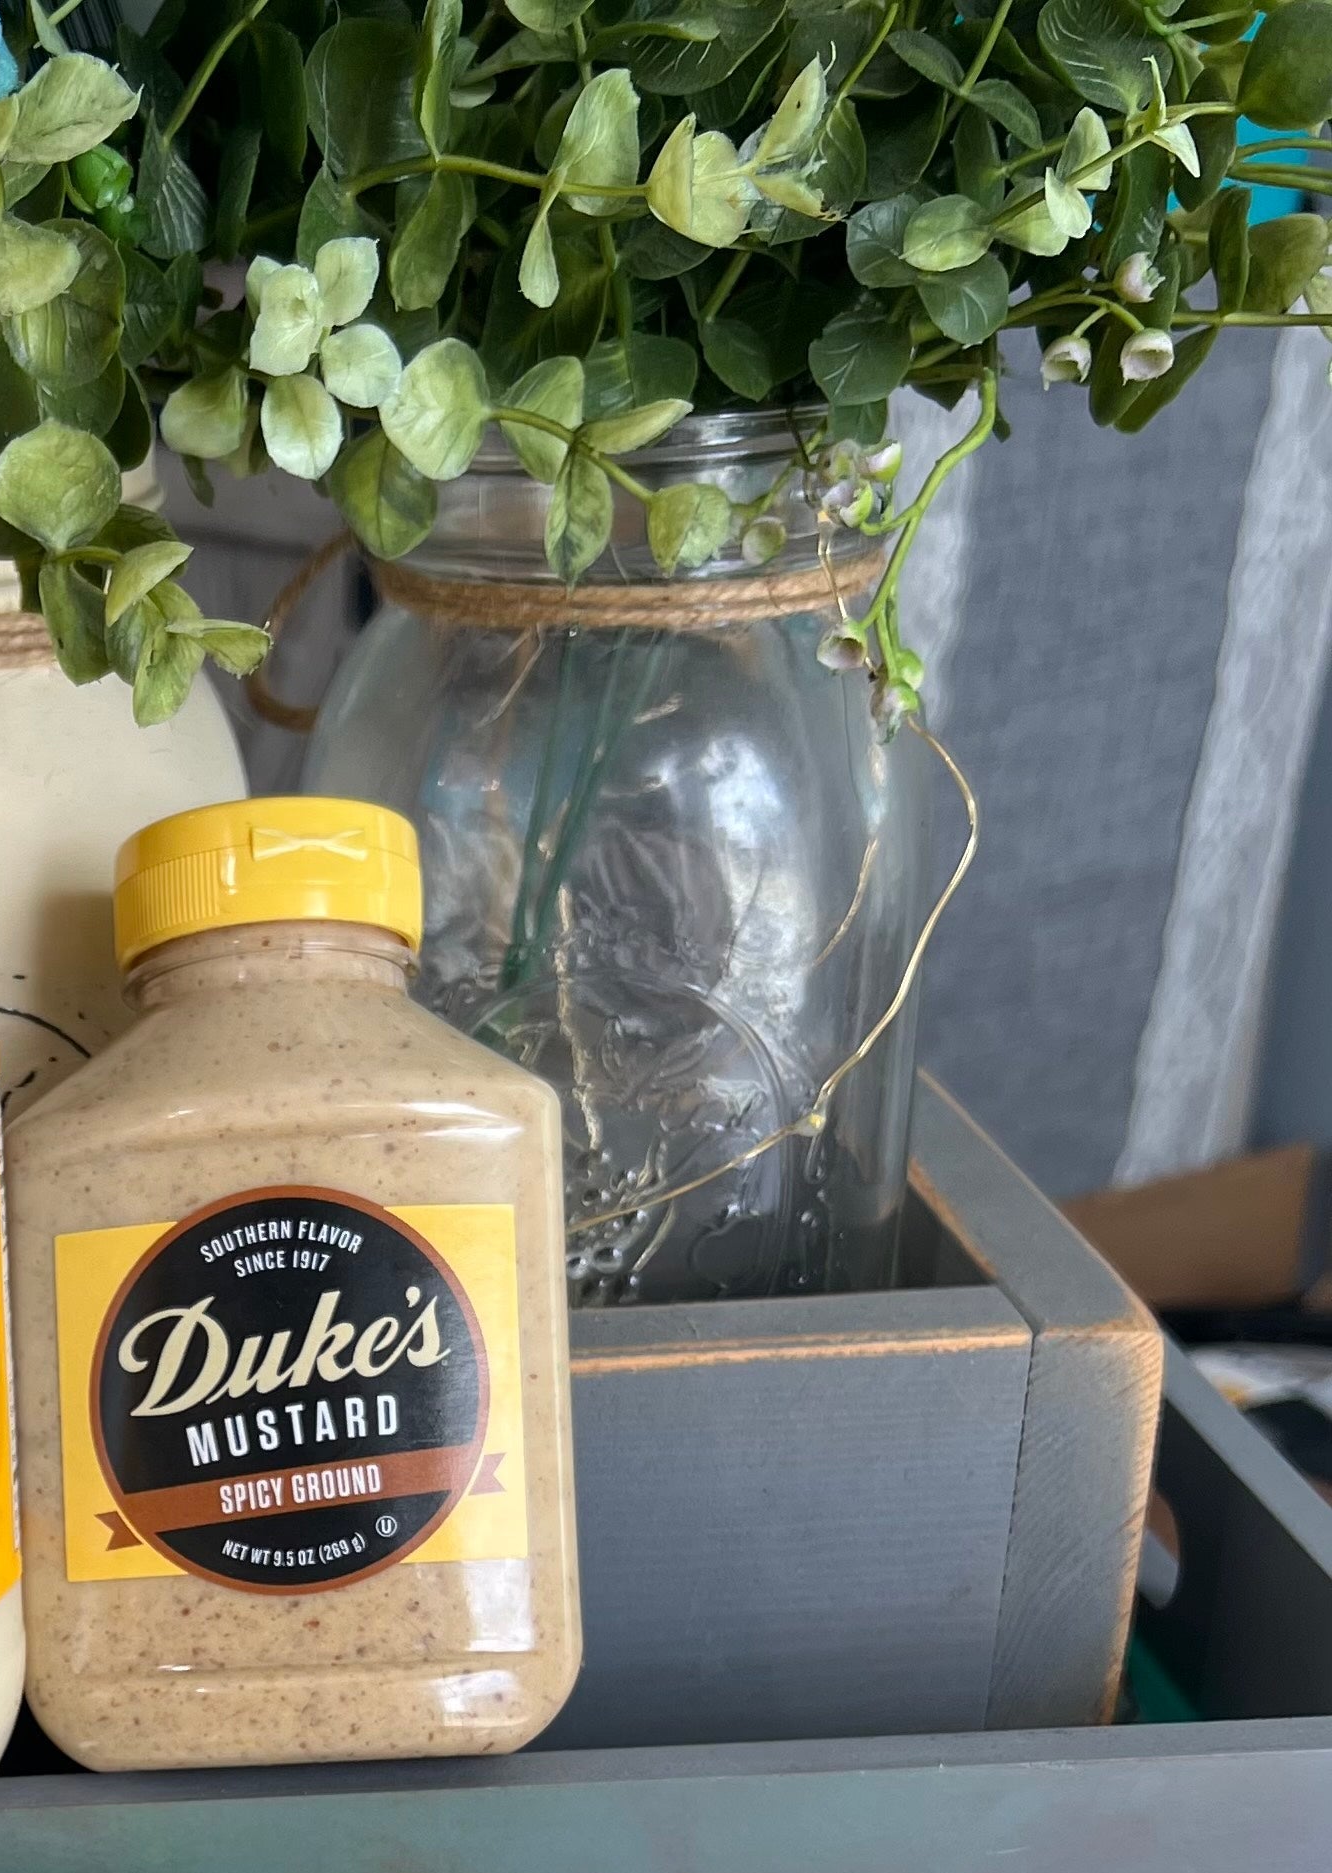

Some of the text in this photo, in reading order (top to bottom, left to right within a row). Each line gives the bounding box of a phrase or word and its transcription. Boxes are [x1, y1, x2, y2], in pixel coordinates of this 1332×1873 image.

[199, 1219, 365, 1263] SOUTHERN FLAVOR
[234, 1250, 333, 1278] SINCE 1917
[118, 1285, 452, 1418] Duke's
[185, 1394, 399, 1467] MUSTARD
[219, 1463, 382, 1515] SPICY GROUND
[221, 1531, 367, 1567] NET WT 9.5 OZ (269 g)
